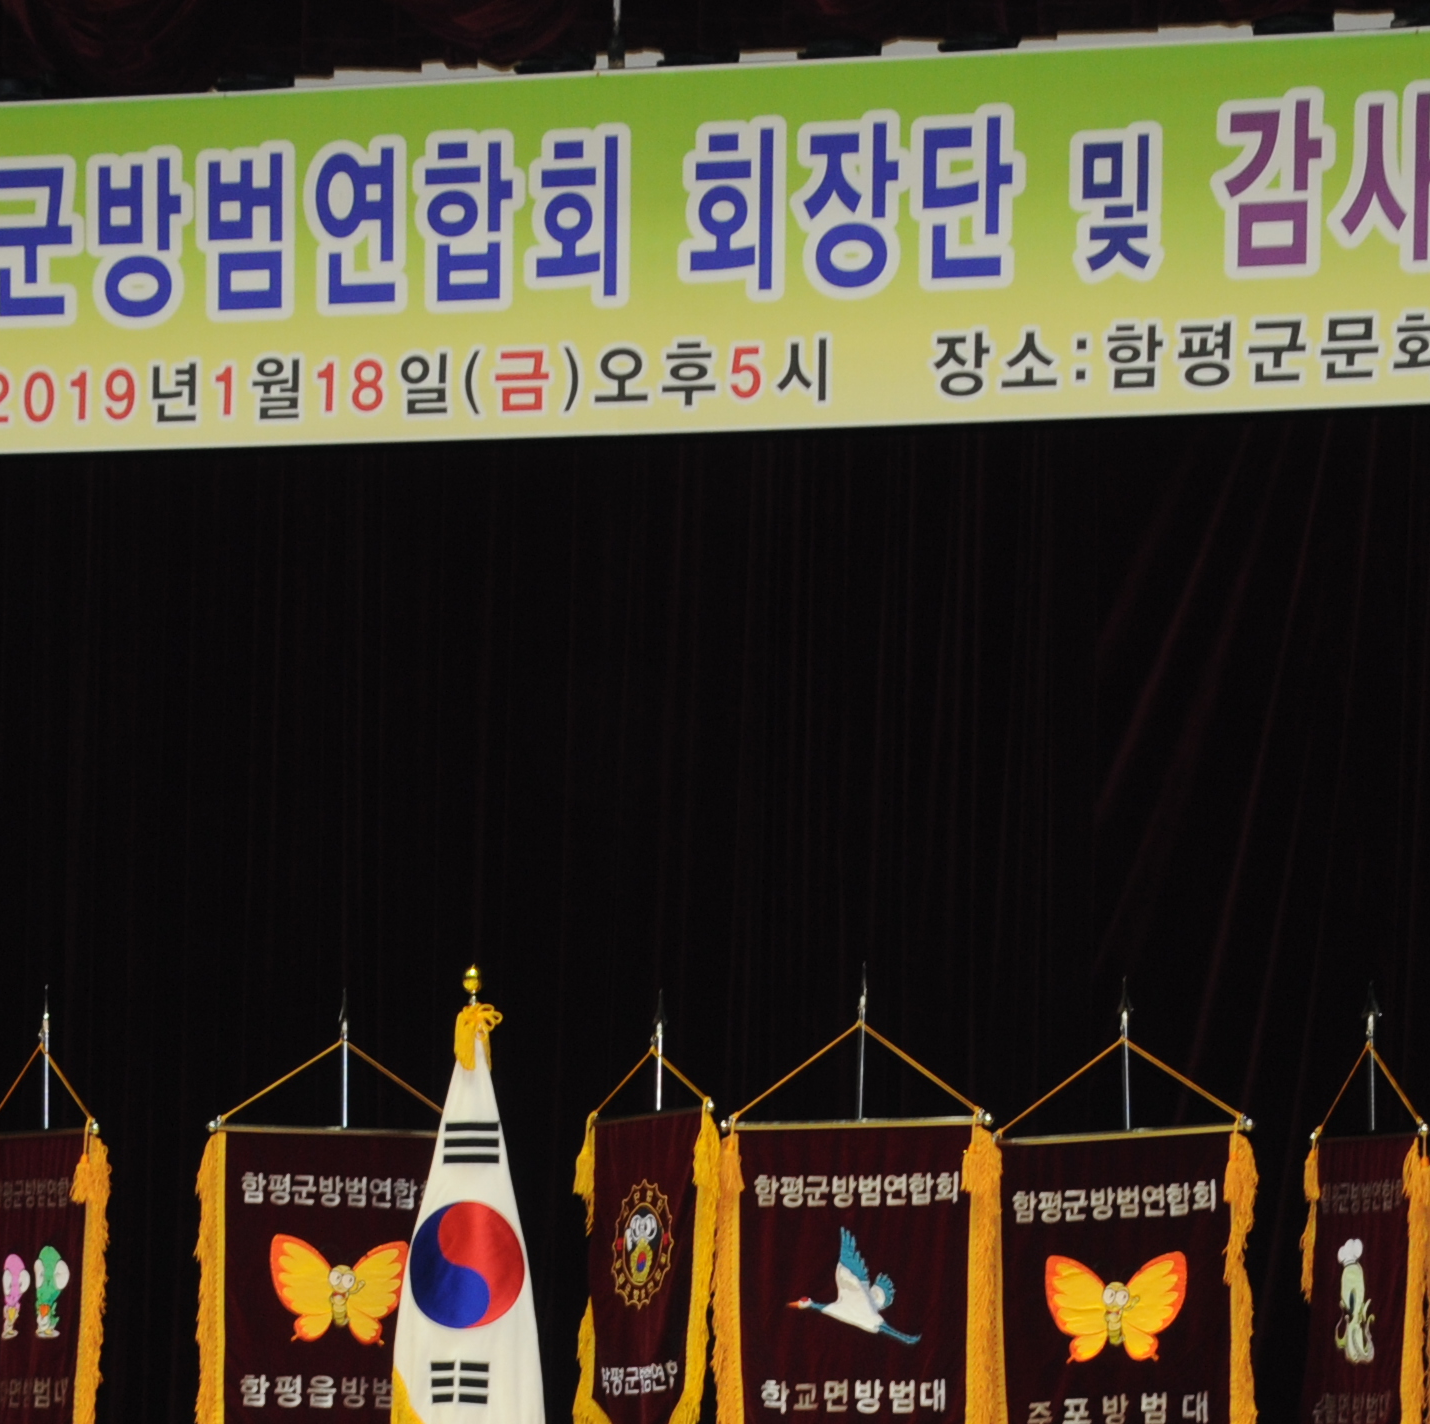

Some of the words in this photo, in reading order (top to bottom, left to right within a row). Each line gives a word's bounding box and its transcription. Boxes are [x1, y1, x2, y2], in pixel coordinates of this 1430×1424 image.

[689, 115, 1014, 291] 회장단
[1079, 133, 1153, 272] 및
[241, 1171, 427, 1210] 함평군방범연합
[753, 1171, 961, 1208] 함평군방범연합회
[1011, 1179, 1217, 1224] 함평군방범연합회
[239, 1374, 394, 1410] 함평읍방범
[760, 1378, 947, 1415] 학교면방범대
